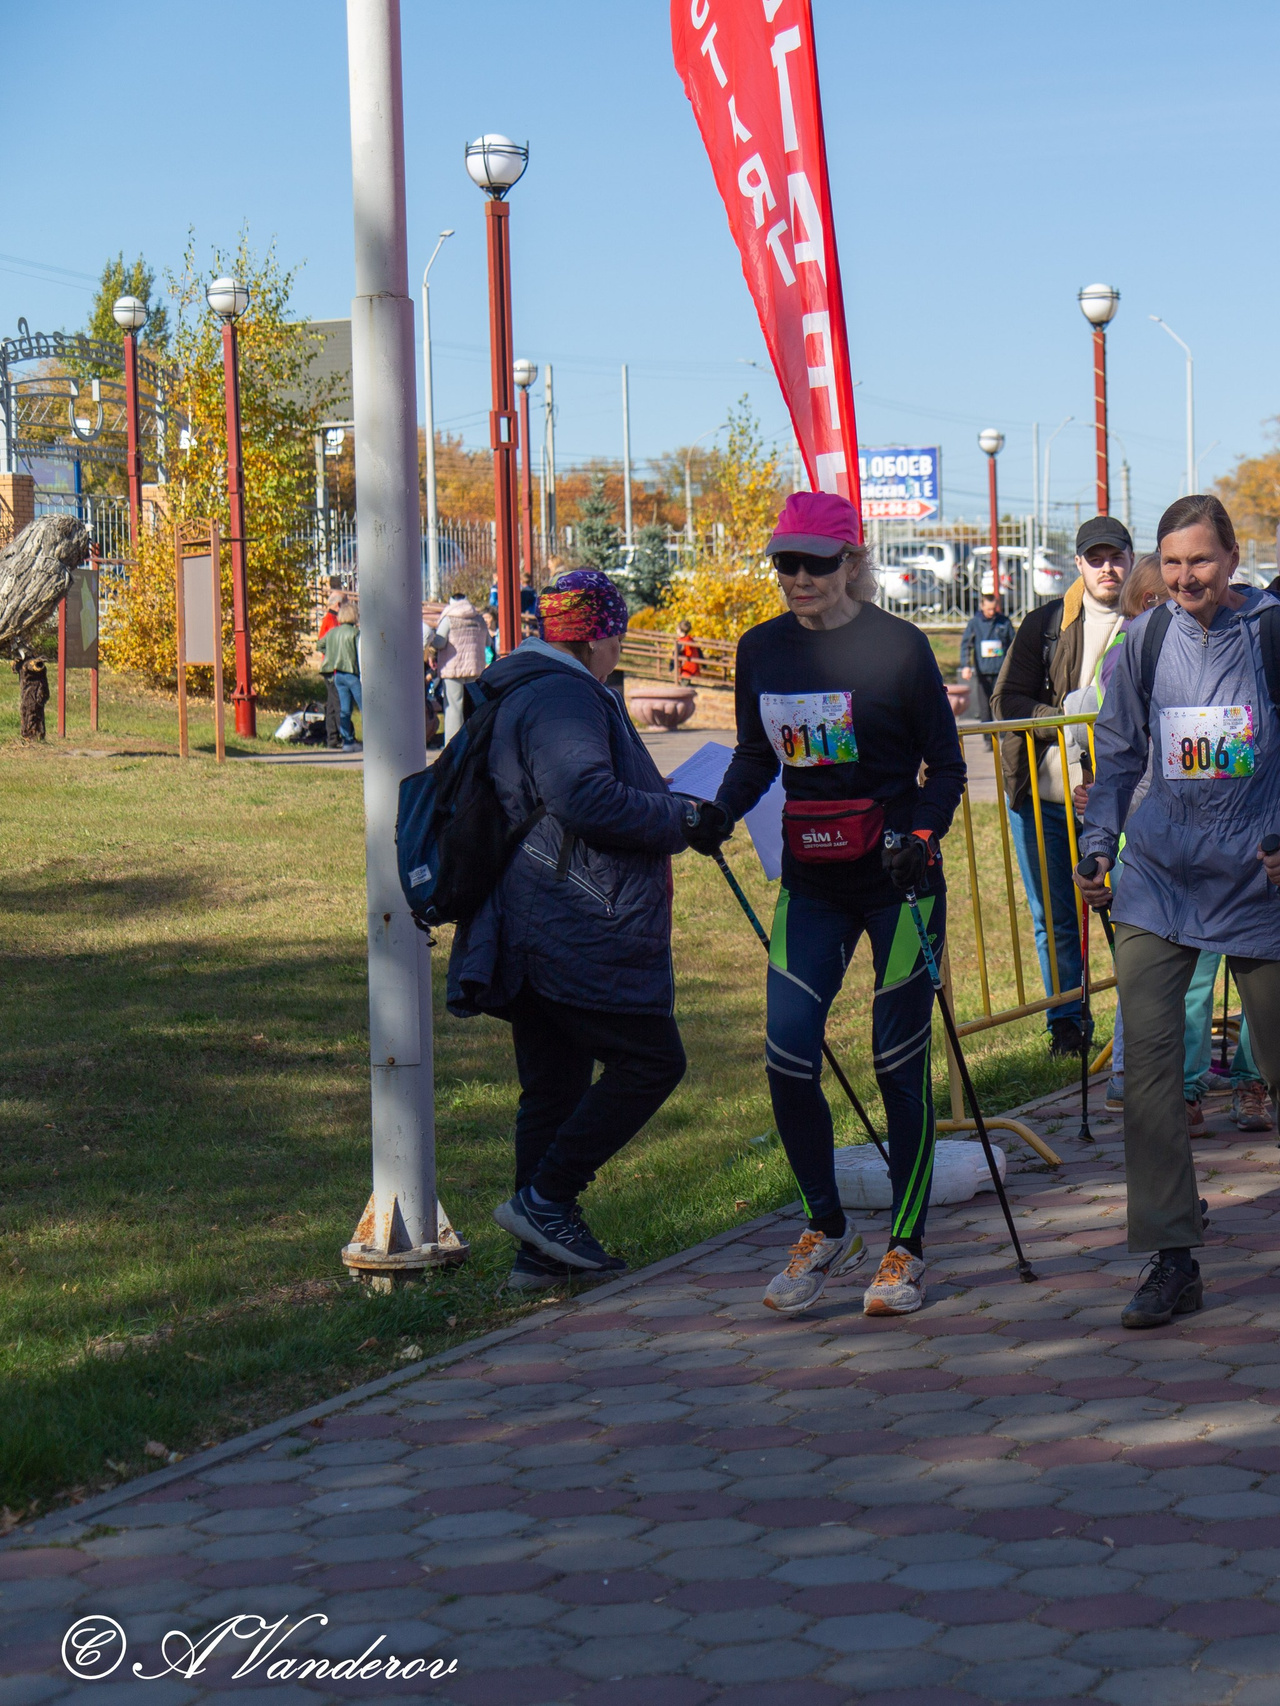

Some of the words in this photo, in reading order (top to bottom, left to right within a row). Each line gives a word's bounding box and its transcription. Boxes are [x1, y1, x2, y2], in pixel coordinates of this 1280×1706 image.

[871, 454, 933, 478] ОБОЕВ
[781, 723, 829, 758] 811
[1181, 736, 1229, 770] 806
